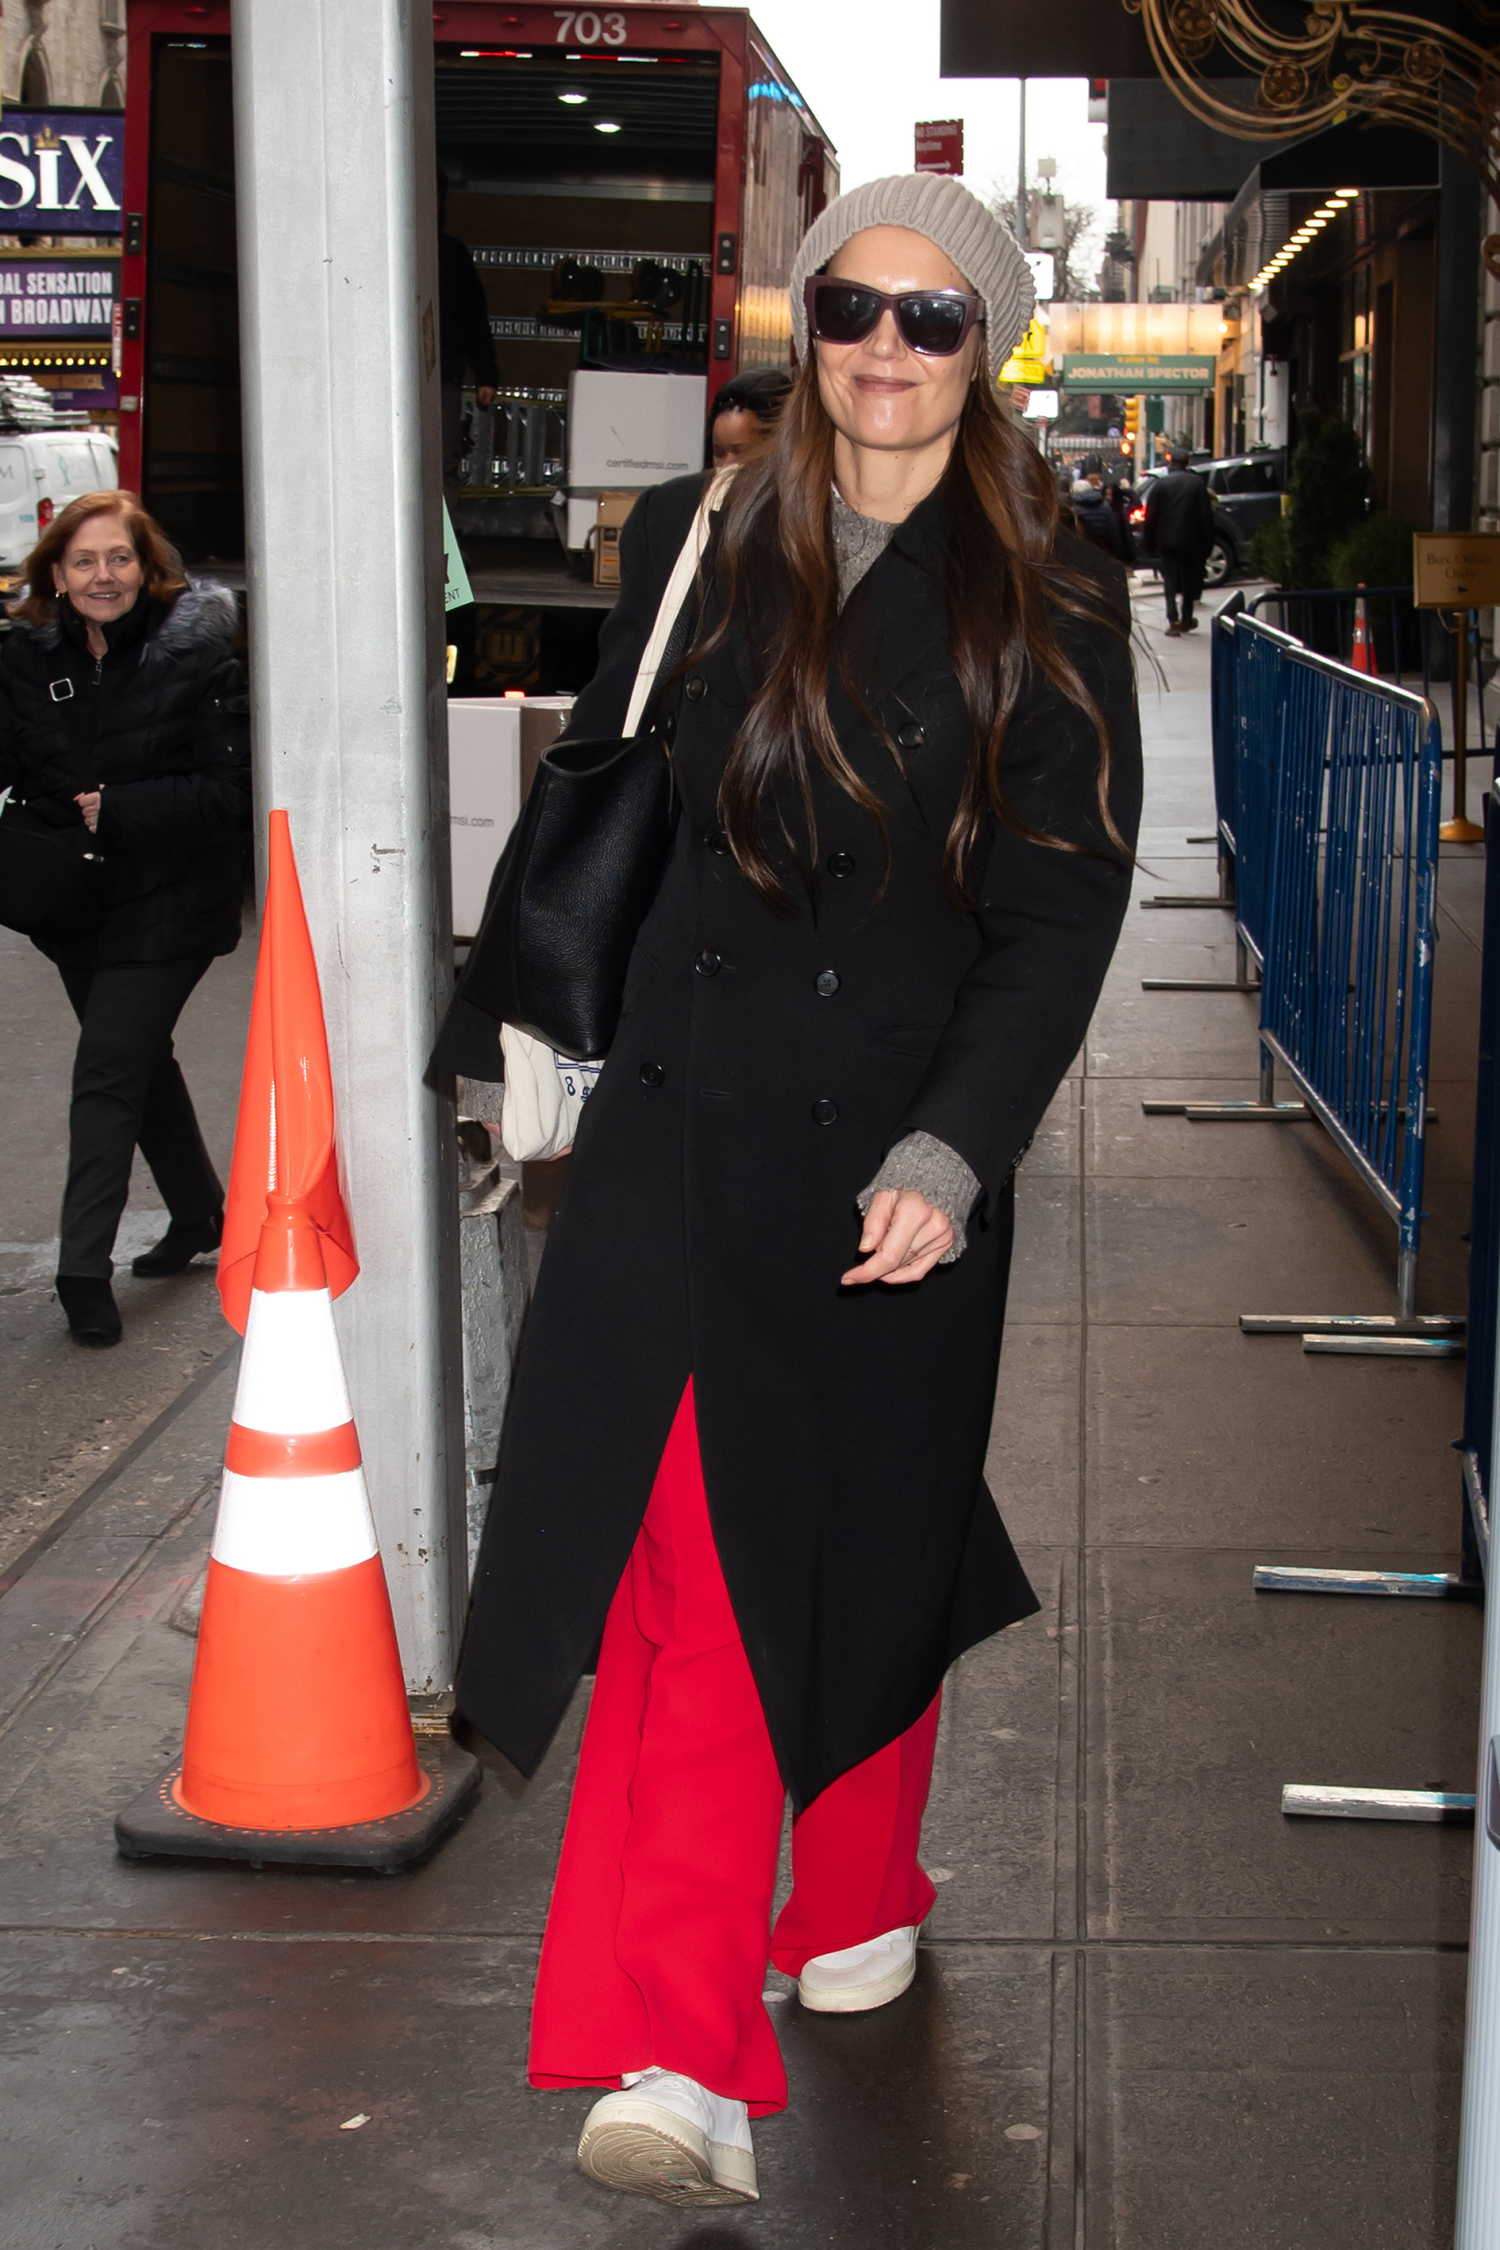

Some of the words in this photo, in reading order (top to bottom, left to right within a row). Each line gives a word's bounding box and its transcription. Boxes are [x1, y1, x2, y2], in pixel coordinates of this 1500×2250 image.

[553, 11, 627, 46] 703
[0, 131, 122, 211] SIX
[26, 271, 113, 295] SENSATION
[10, 298, 113, 325] BROADWAY
[1068, 367, 1144, 380] JONATHAN
[1147, 367, 1210, 380] SPECTOR
